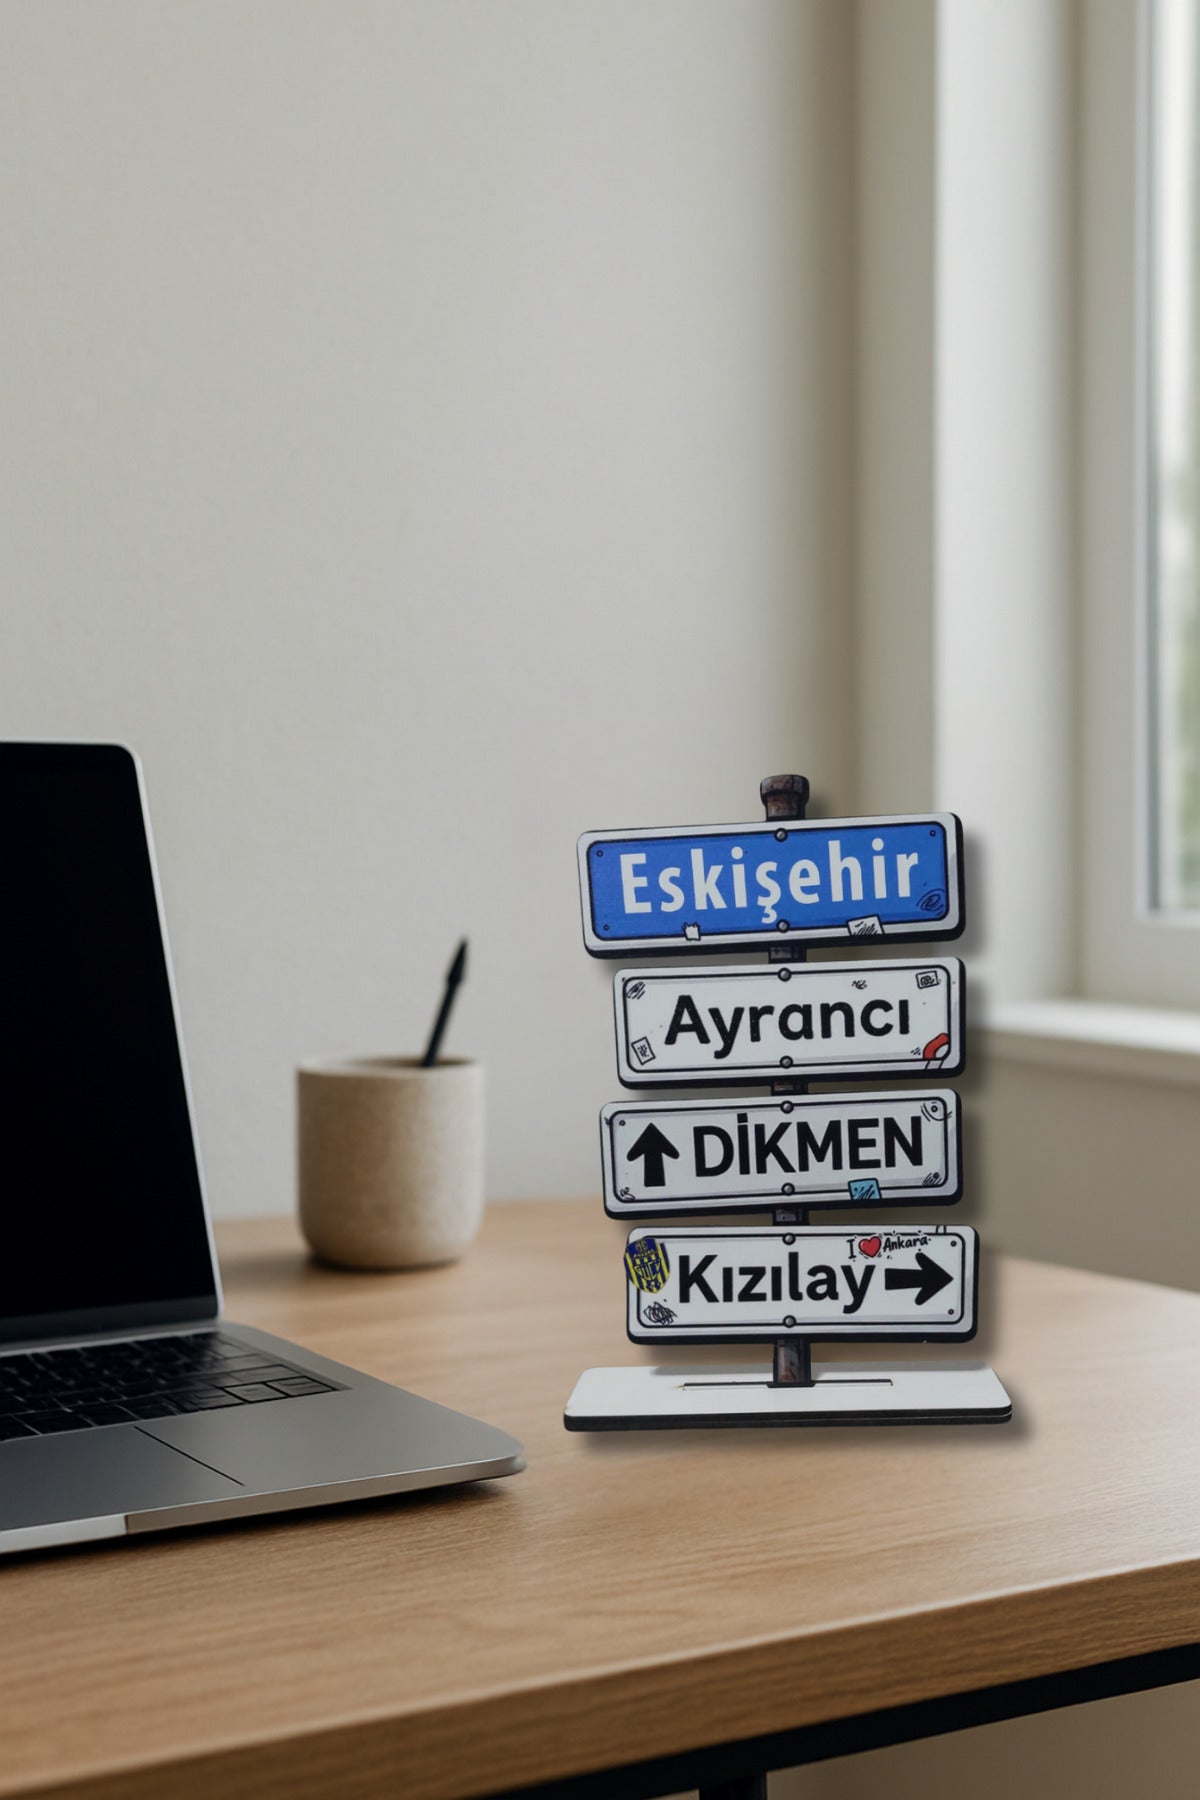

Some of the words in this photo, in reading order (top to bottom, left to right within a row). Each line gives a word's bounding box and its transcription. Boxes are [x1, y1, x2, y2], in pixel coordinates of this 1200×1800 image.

[619, 838, 919, 924] Eskişehir
[664, 994, 910, 1059] Ayrancı
[692, 1113, 924, 1178] DİKMEN
[846, 1238, 857, 1260] I
[882, 1235, 929, 1253] Ankara
[678, 1251, 876, 1314] Kızılay
